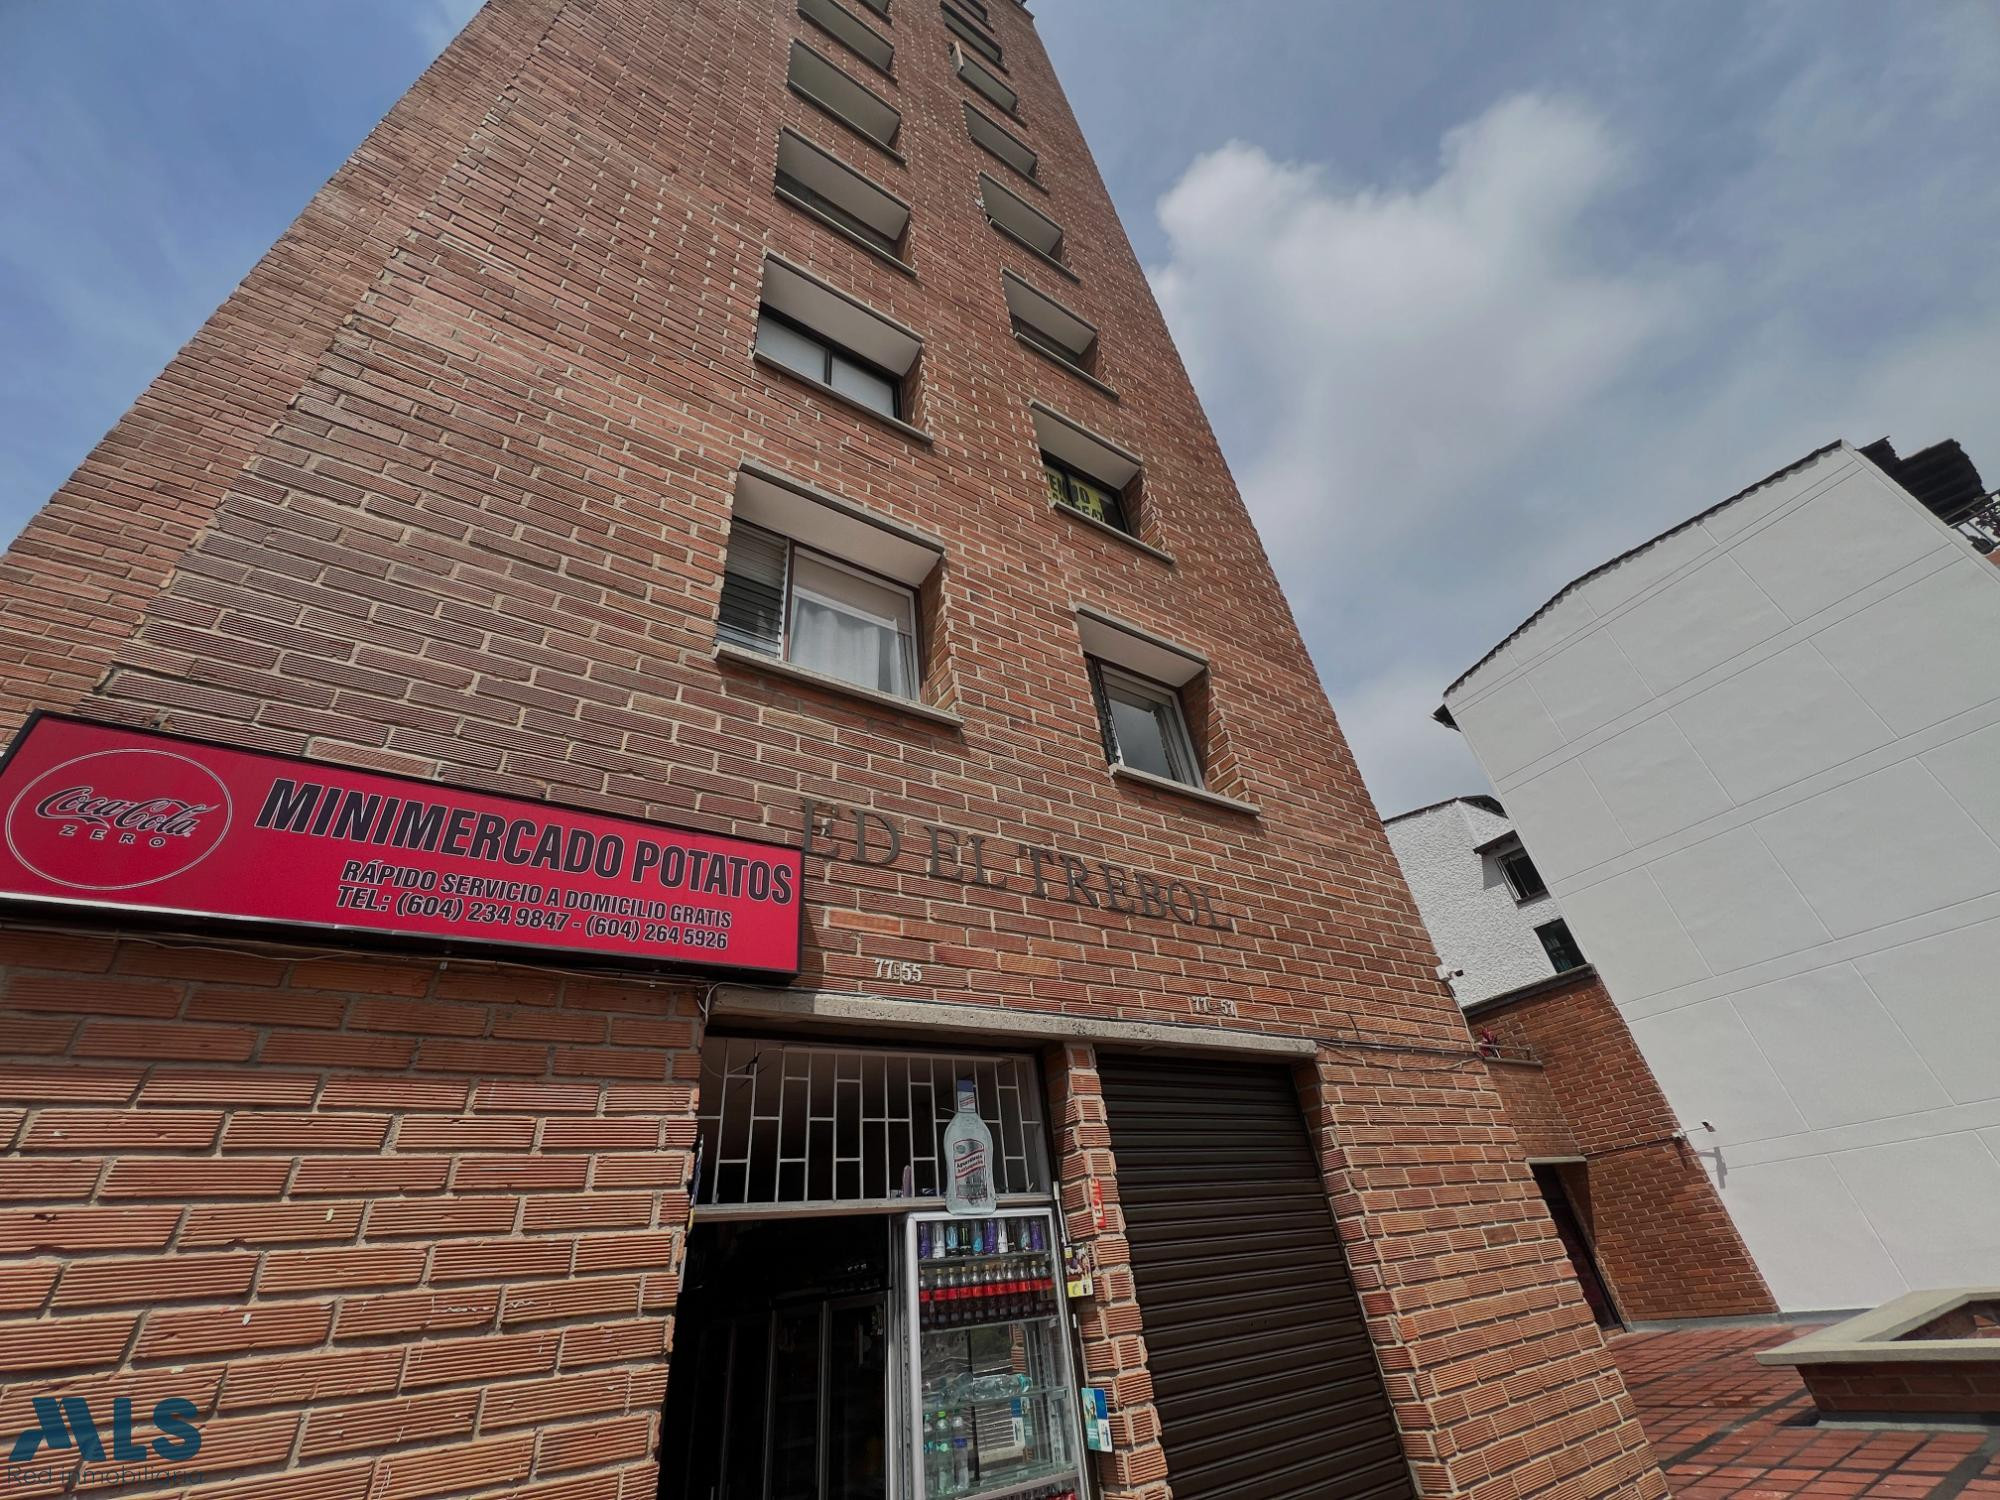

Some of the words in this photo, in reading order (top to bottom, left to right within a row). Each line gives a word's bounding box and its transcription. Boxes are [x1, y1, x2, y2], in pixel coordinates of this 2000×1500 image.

[35, 786, 220, 838] Coca-Cola
[59, 825, 166, 848] ZERO
[254, 777, 624, 879] MINIMERCADO
[630, 840, 793, 905] POTATOS
[340, 859, 437, 891] RÁPIDO
[440, 872, 543, 905] SERVICIO
[544, 888, 562, 907] A
[564, 889, 667, 920] DOMICILIO
[670, 905, 732, 929] GRATIS
[924, 825, 1007, 889] EL
[1018, 843, 1234, 932] TREBOL
[336, 885, 391, 911] TEL:
[396, 892, 463, 922] (604)
[467, 902, 511, 925] 234
[514, 908, 570, 932] 9847
[585, 914, 641, 942] (604)
[644, 923, 680, 945] 264
[683, 929, 728, 950] 5926
